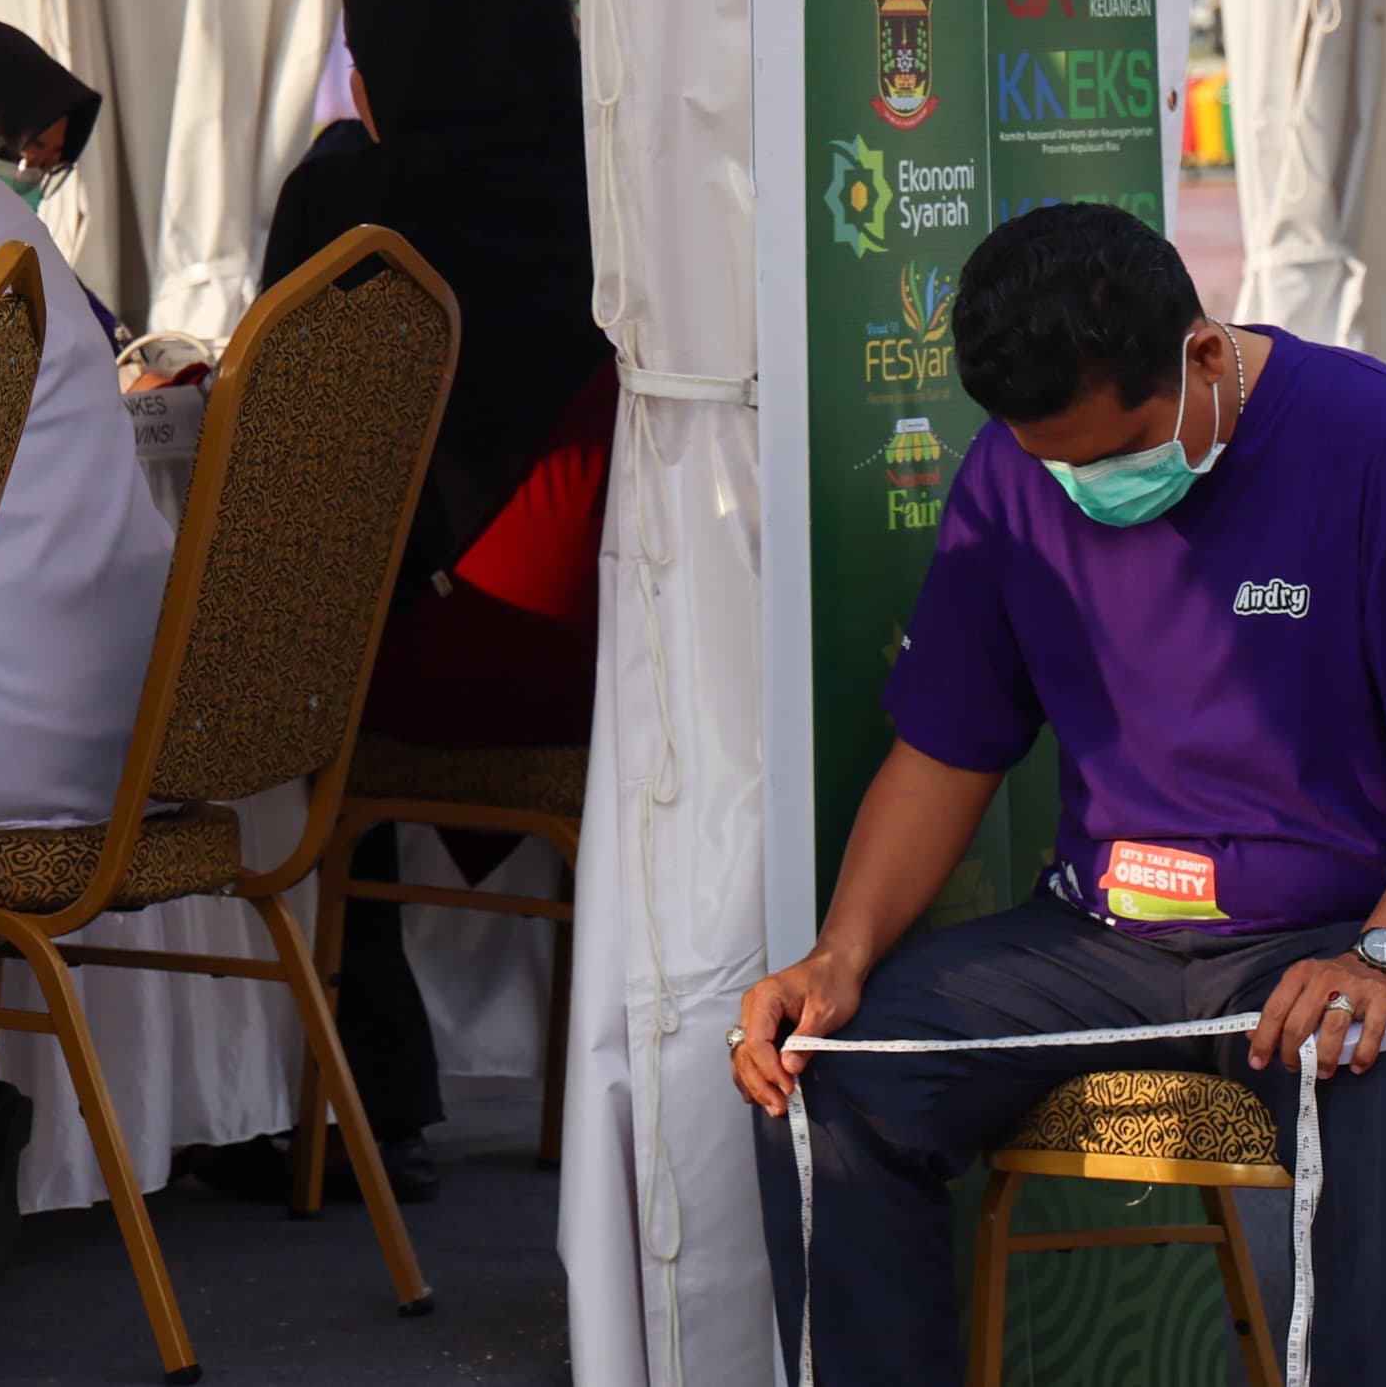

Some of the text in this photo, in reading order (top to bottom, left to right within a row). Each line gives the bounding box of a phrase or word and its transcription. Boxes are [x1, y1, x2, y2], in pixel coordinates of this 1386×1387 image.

[898, 159, 975, 193] Ekonomi
[900, 194, 969, 237] Syariah
[865, 338, 952, 391] FESyar
[886, 488, 942, 531] Fair
[1235, 579, 1309, 618] Andry
[1115, 861, 1206, 897] OBESITY
[1120, 847, 1209, 874] LET'S TALK ABOUT
